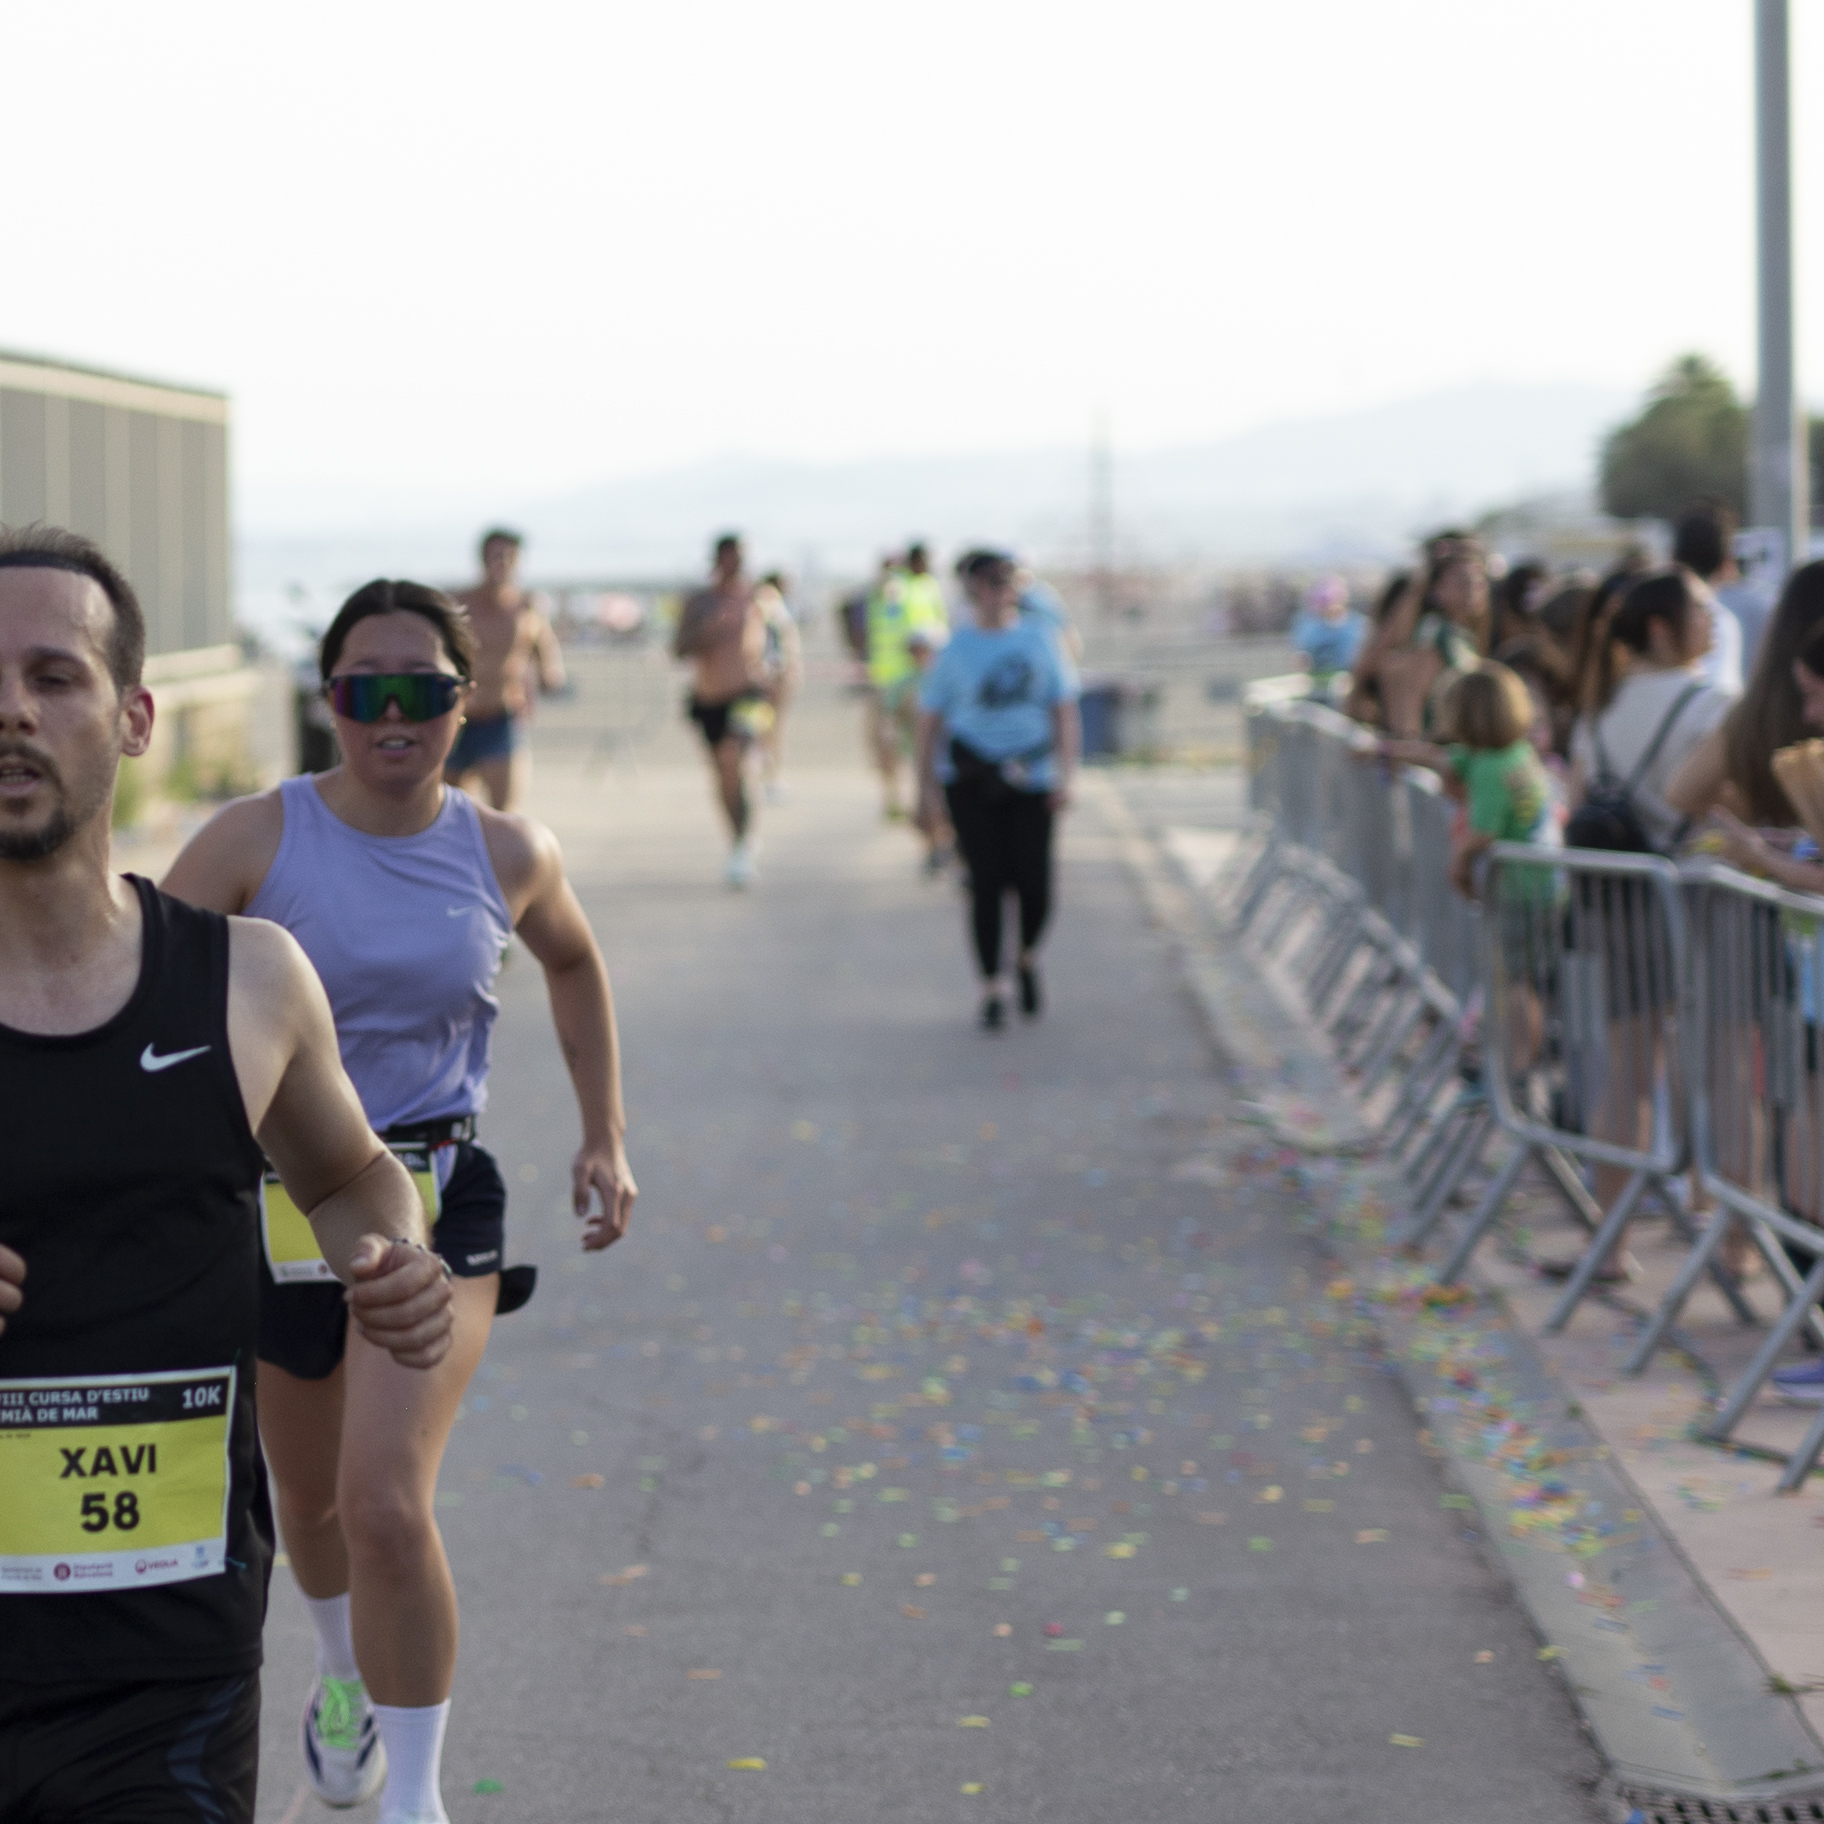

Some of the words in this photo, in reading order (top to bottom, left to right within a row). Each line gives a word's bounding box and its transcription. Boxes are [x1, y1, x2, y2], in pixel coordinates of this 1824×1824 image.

[29, 1390, 83, 1406] CURSA
[87, 1387, 150, 1404] D'ESTIU
[182, 1385, 222, 1409] 10K
[37, 1408, 59, 1422] DE
[62, 1406, 99, 1421] MAR
[59, 1443, 157, 1479] XAVI
[80, 1491, 140, 1533] 58
